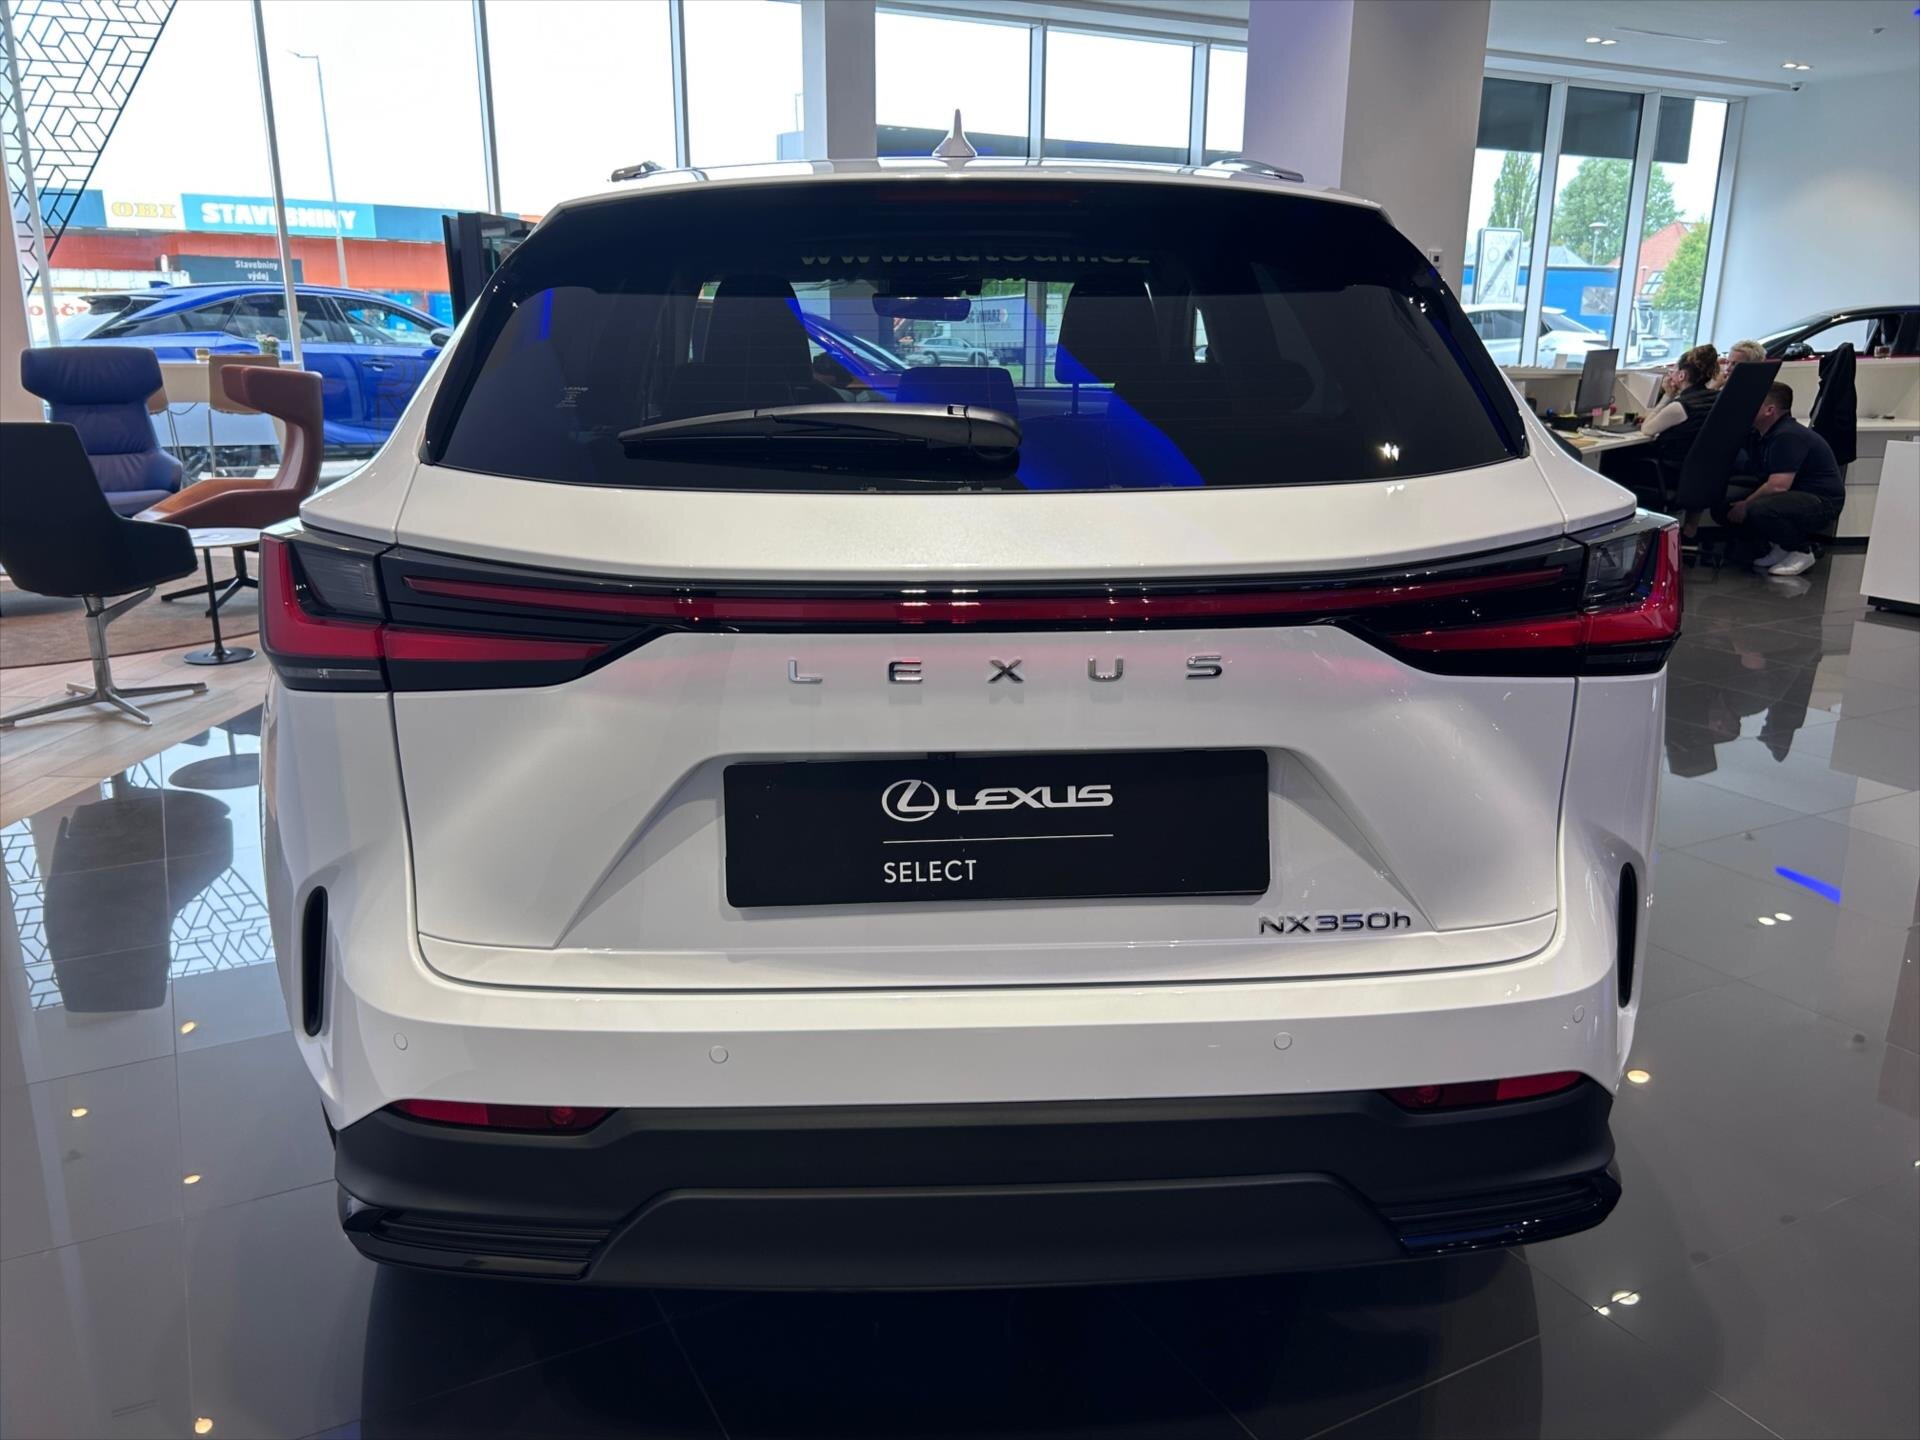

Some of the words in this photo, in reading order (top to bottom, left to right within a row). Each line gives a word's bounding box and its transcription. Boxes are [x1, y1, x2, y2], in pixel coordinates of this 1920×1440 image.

[111, 201, 177, 219] OBI
[235, 259, 278, 271] Stavebniny
[247, 270, 269, 282] výdej
[787, 654, 1223, 684] LEXUS
[946, 784, 1114, 811] LEXUS
[883, 859, 977, 884] SELECT
[1259, 911, 1412, 935] NX350h
